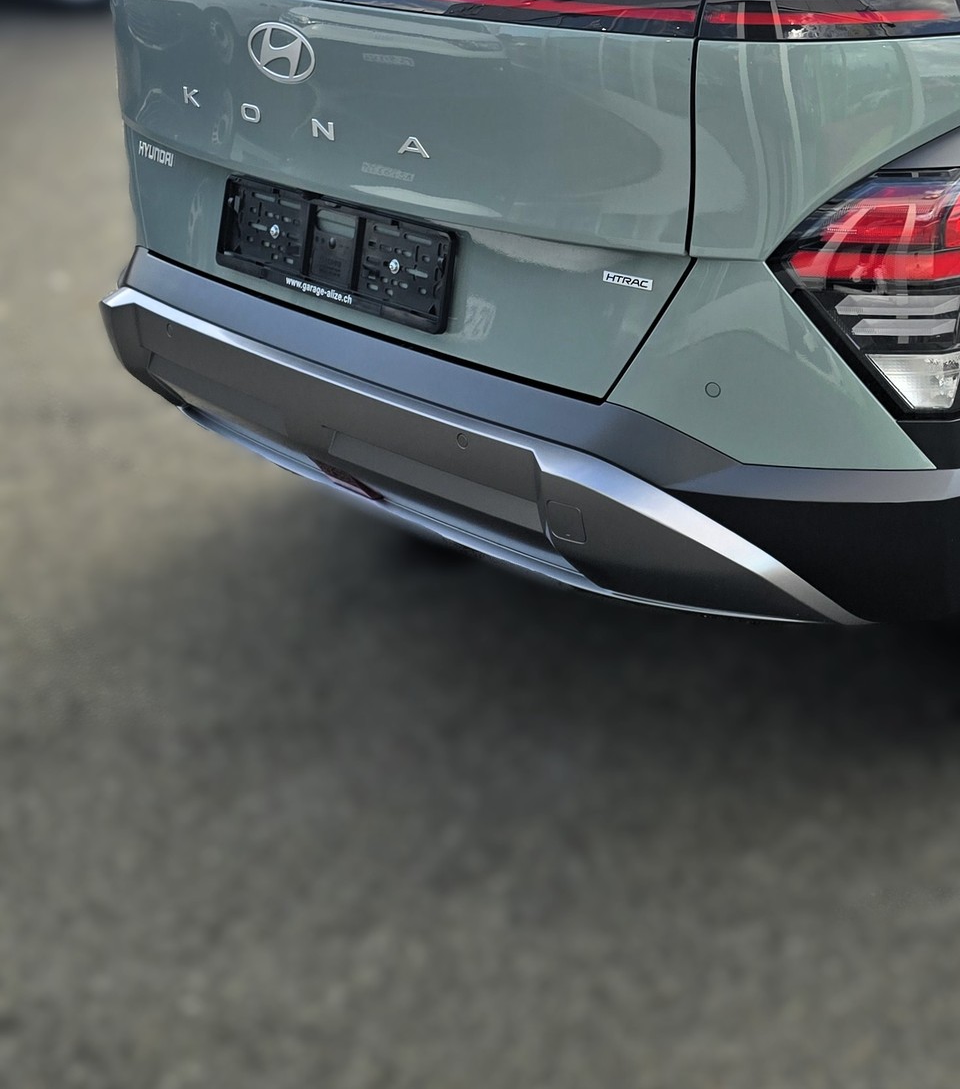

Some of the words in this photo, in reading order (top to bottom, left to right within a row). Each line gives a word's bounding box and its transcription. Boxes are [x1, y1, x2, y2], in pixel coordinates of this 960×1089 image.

[182, 86, 430, 159] KONA
[138, 140, 175, 168] HYUNDAI
[285, 277, 353, 305] www.garage-alize.ch
[605, 273, 649, 289] HTRAC
